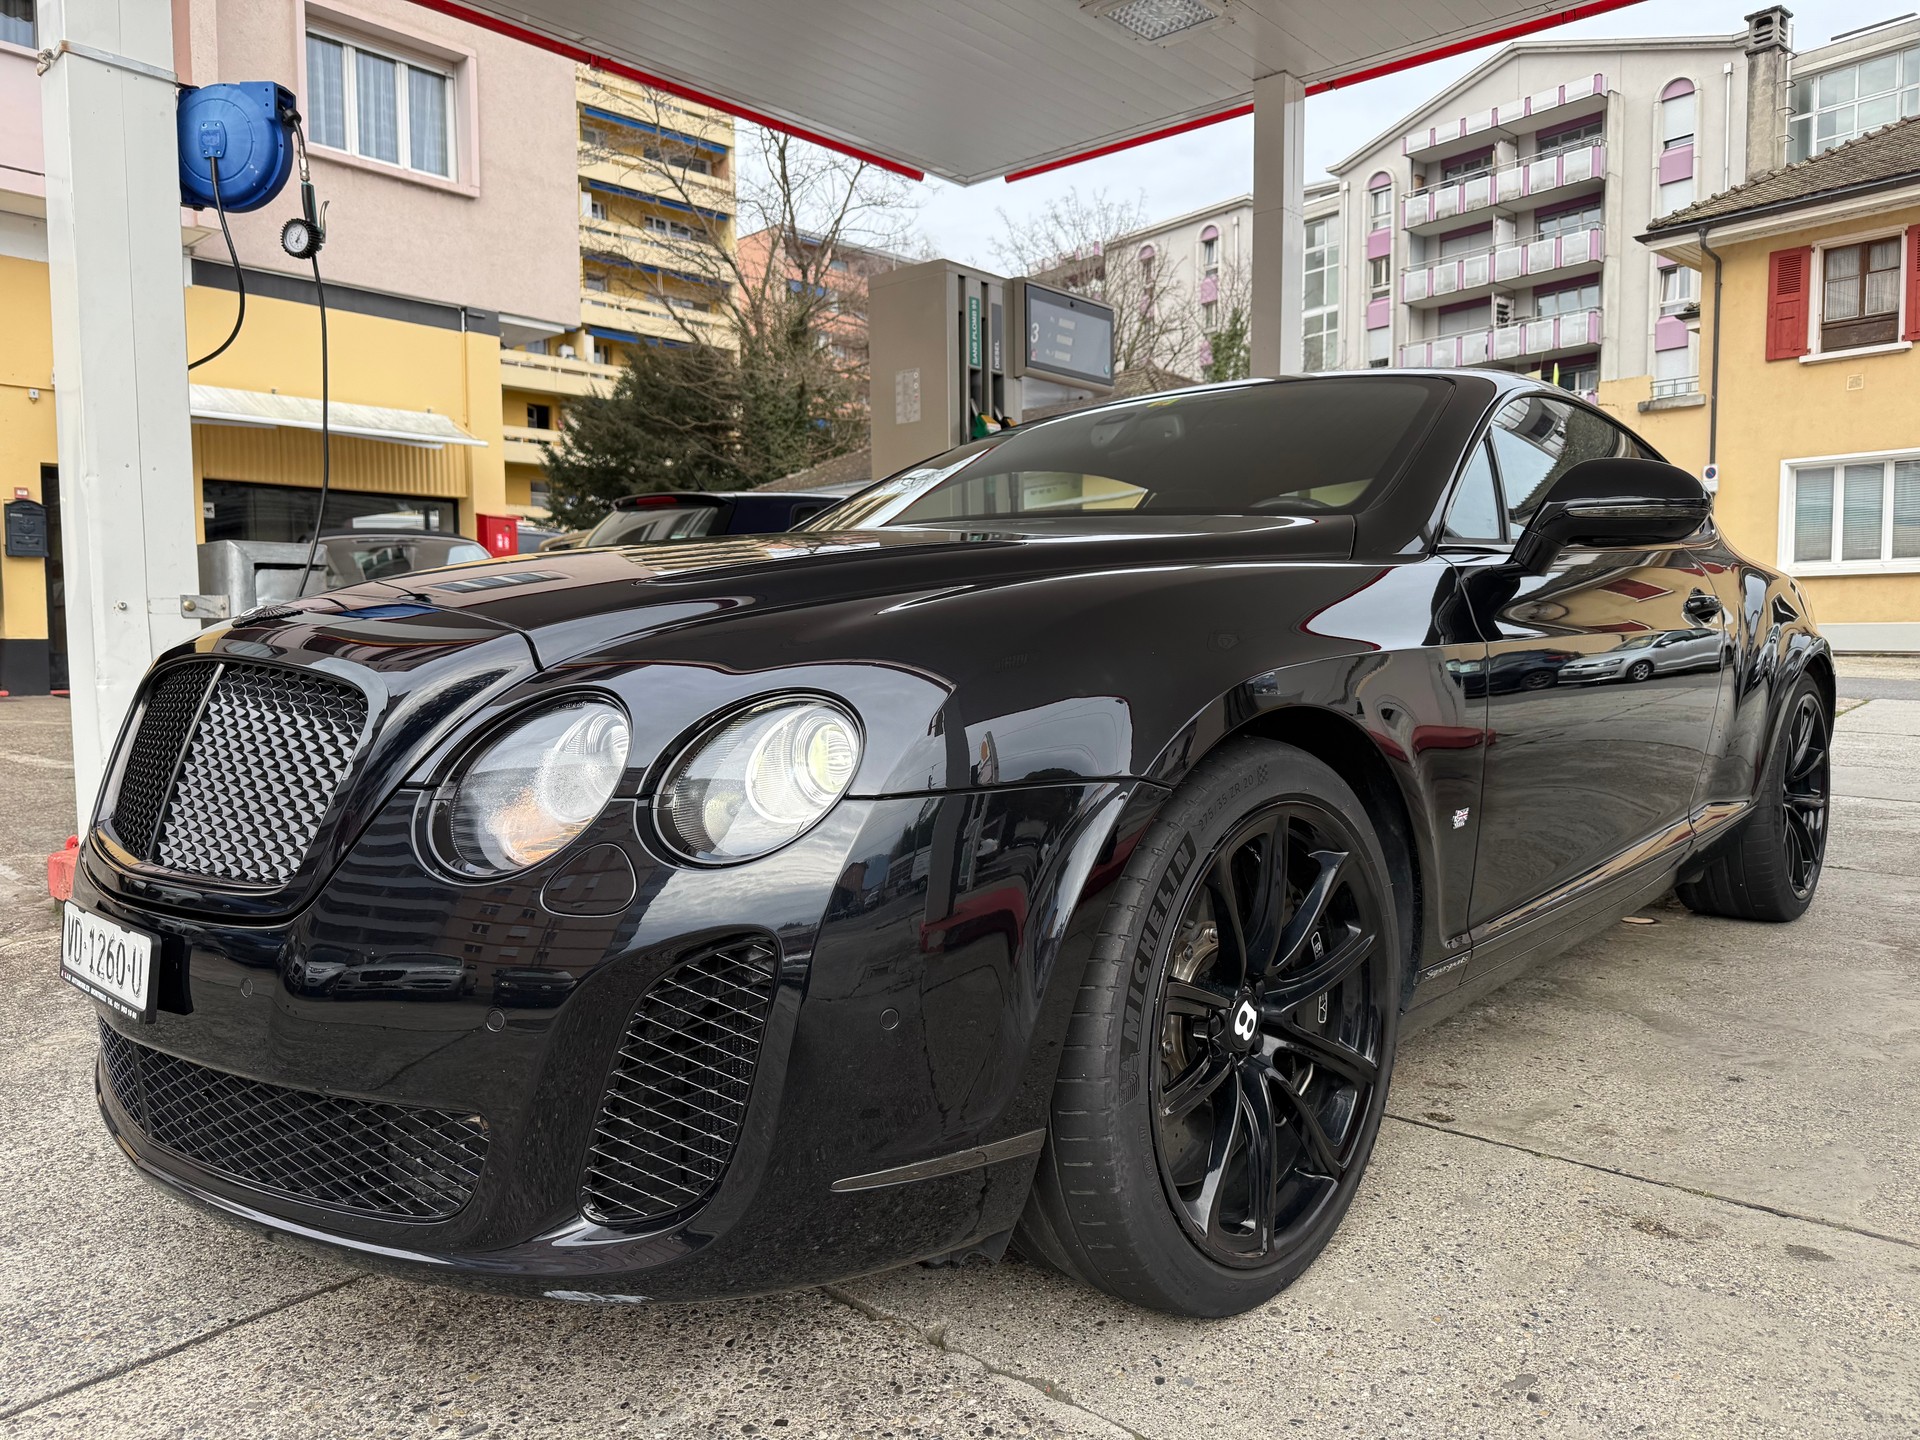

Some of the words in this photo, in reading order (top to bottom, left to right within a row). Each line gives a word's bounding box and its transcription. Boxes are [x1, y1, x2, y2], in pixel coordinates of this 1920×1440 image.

[1031, 322, 1039, 343] 3
[1228, 782, 1241, 799] ZR
[1243, 774, 1254, 789] 20
[1123, 839, 1193, 1044] MICHELIN
